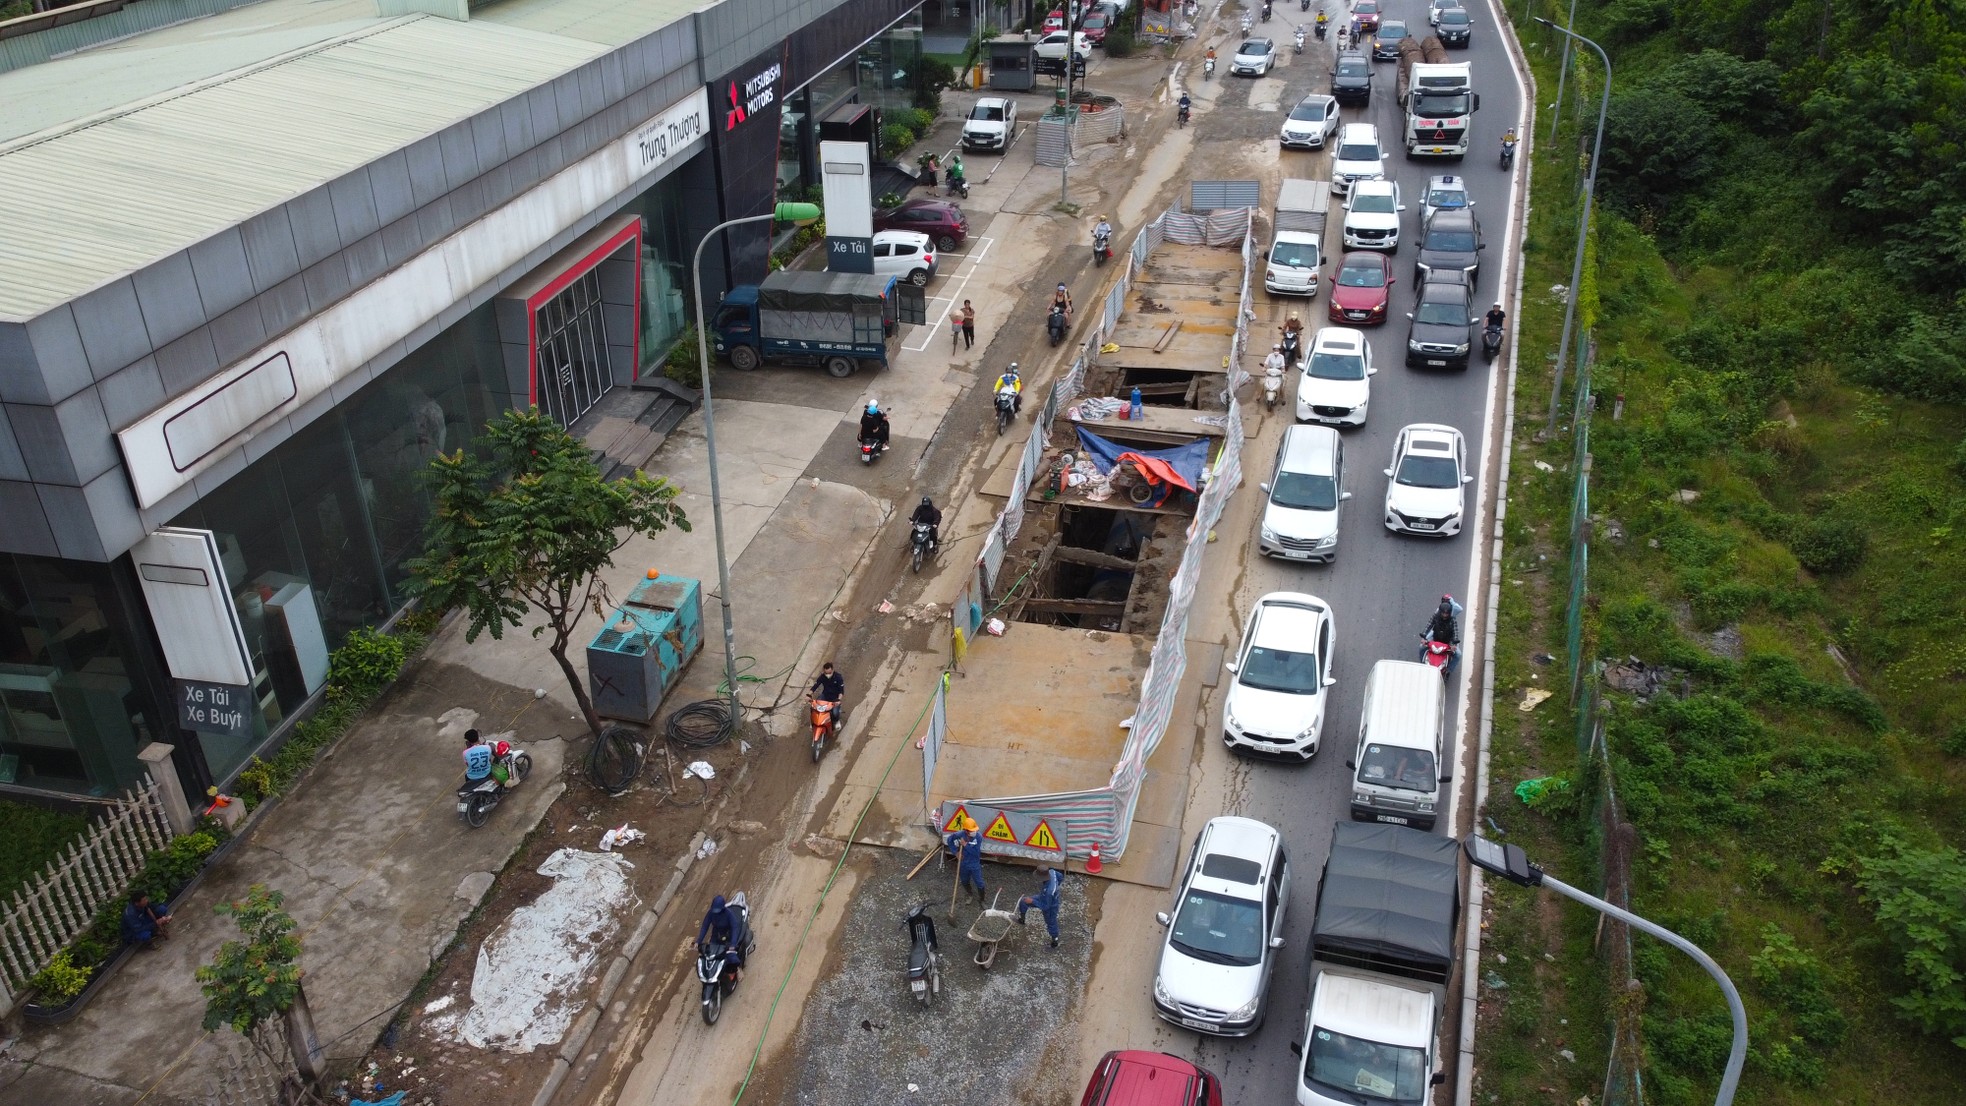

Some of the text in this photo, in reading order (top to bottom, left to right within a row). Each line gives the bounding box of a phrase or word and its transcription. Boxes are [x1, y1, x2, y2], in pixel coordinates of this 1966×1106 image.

[745, 63, 781, 99] MITSUBISHI
[747, 87, 774, 117] MOTORS
[640, 134, 667, 166] Trung
[667, 111, 701, 147] Thượng
[833, 240, 866, 254] Xe Tải
[186, 685, 230, 706] Xe Tải
[187, 705, 242, 730] Xe Buýt
[470, 755, 488, 769] 23
